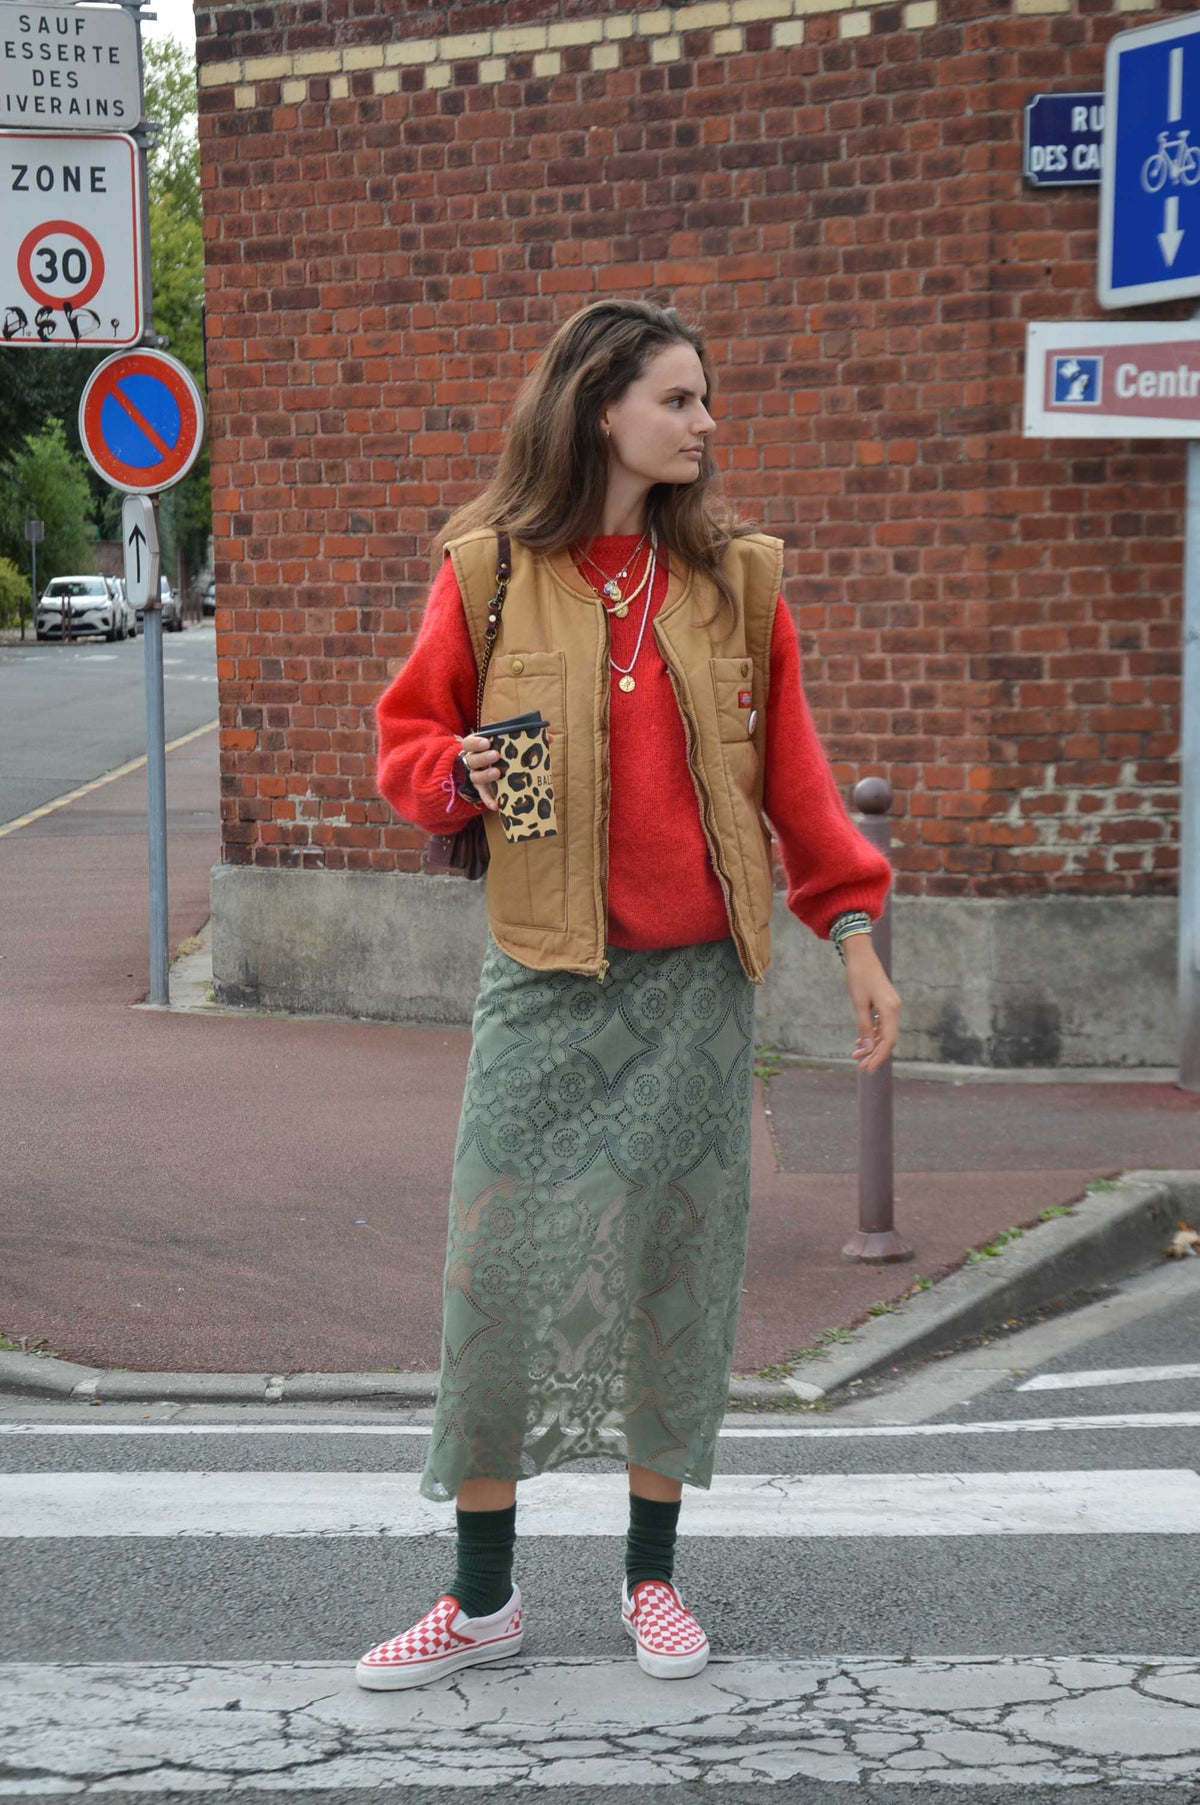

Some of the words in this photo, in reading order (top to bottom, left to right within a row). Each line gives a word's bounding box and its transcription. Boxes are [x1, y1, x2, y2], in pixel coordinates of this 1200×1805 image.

[19, 14, 86, 36] SAUF
[5, 41, 120, 64] ESSERTE
[32, 69, 79, 88] DES
[1030, 144, 1068, 171] DES
[11, 164, 107, 193] ZONE
[35, 247, 87, 284] 30
[1115, 362, 1200, 398] Centr
